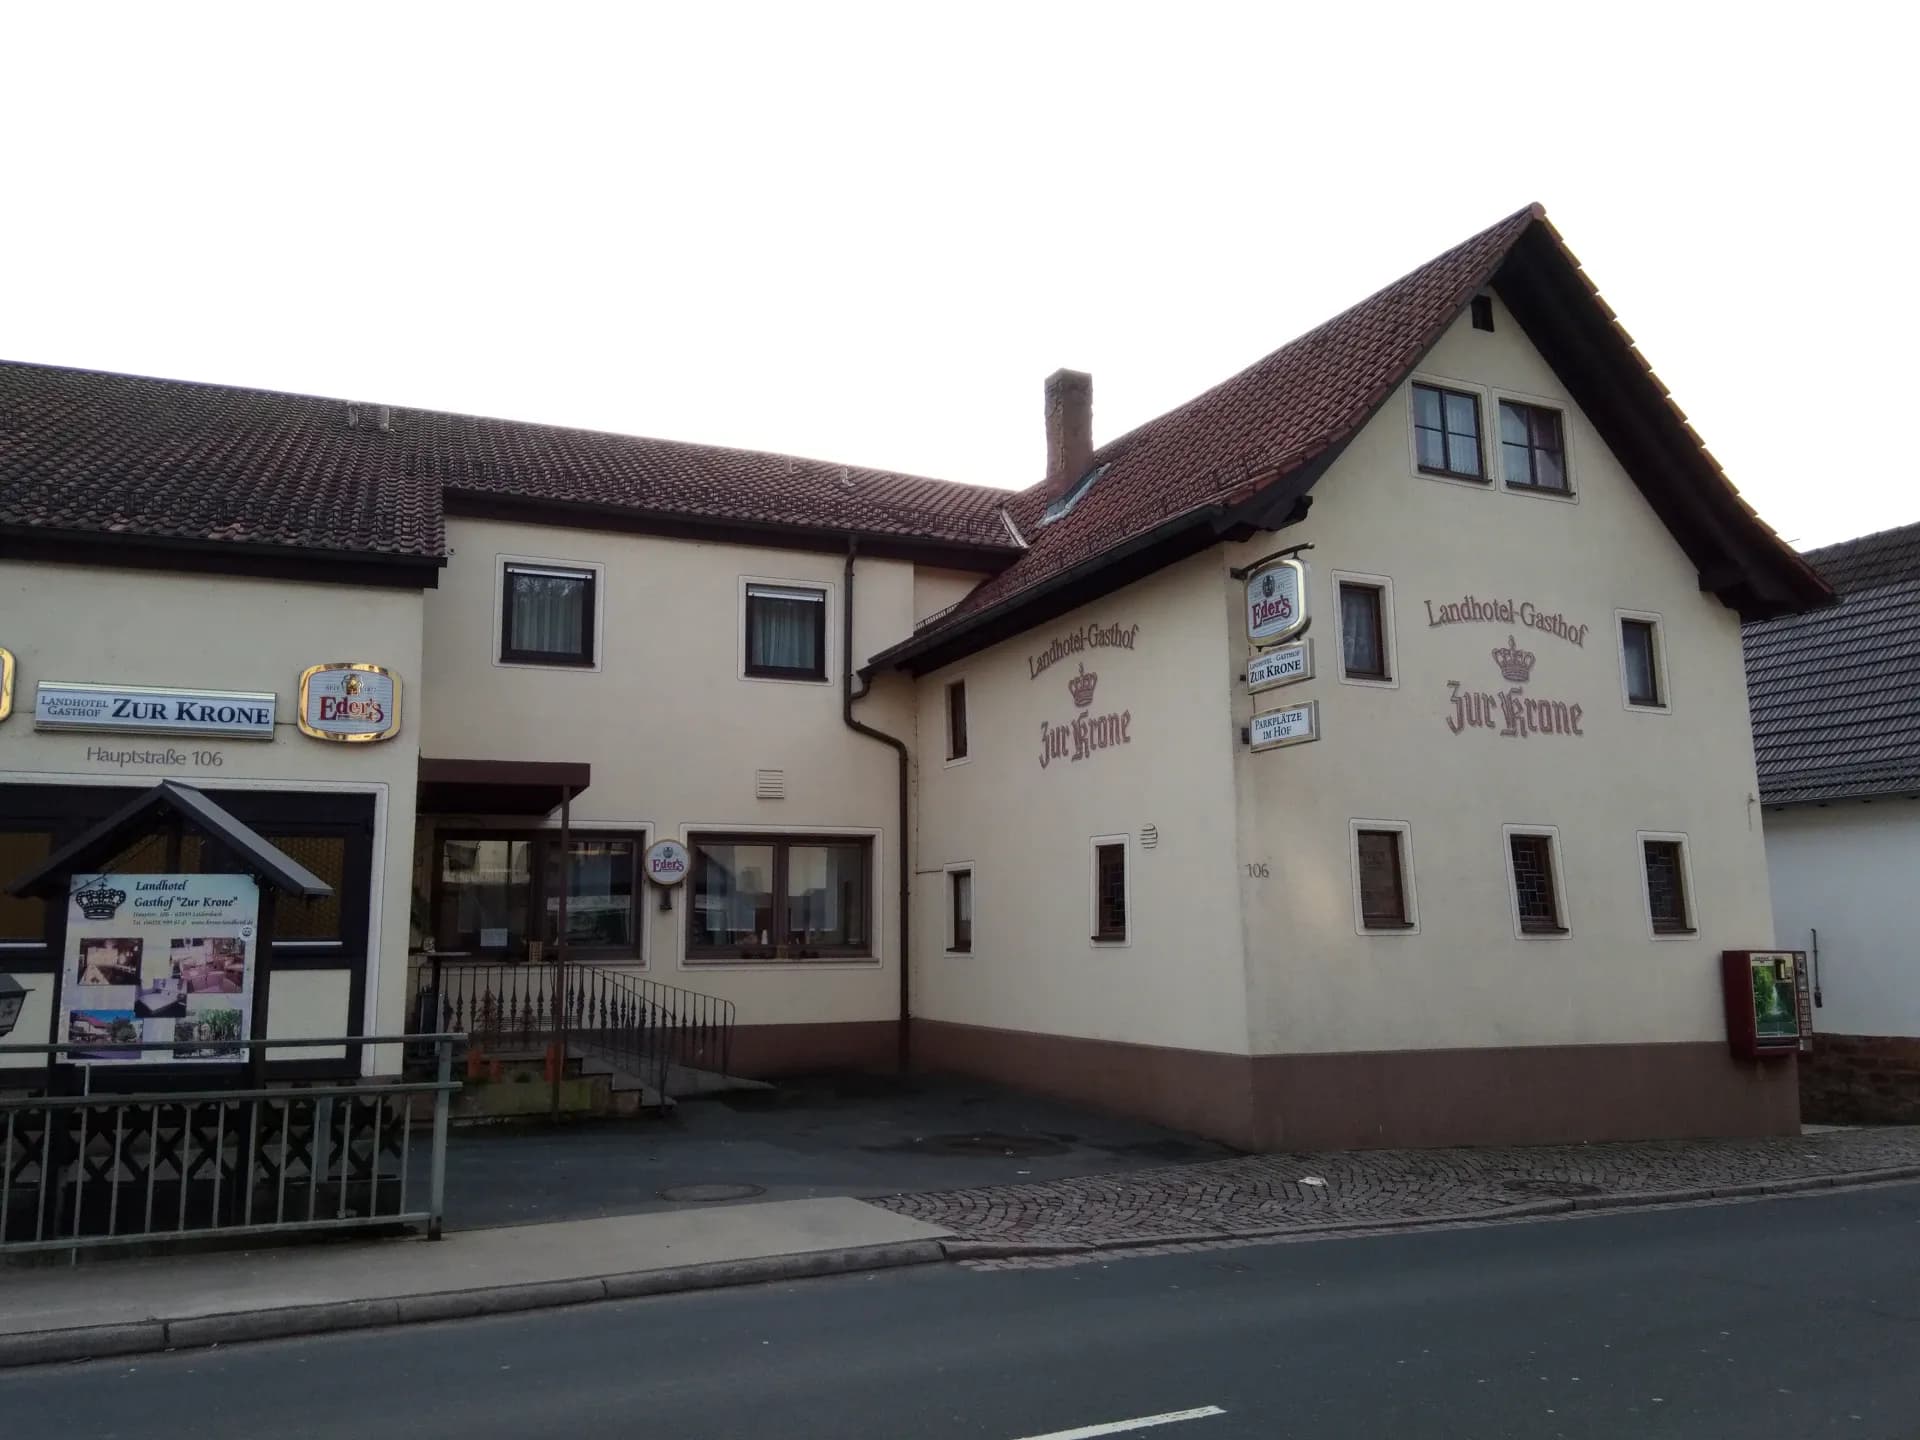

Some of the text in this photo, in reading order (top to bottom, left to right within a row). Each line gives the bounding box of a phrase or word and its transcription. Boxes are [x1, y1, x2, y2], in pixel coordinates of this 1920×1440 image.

[1252, 594, 1292, 629] Eder's
[1424, 595, 1589, 648] Landhotel-Gasthof
[1028, 622, 1139, 680] Landhotel-Gasthof
[1250, 660, 1301, 683] ZUR KRONE
[41, 695, 108, 708] LANDHOTEL
[48, 705, 101, 717] GASTHOF
[112, 698, 270, 725] ZUR KRONE
[319, 696, 384, 723] Eder's
[1446, 680, 1584, 738] Zur Krone
[1255, 712, 1302, 730] PARKPLÄTZE
[1274, 726, 1292, 737] HOF
[1039, 709, 1131, 769] Zur Krone
[86, 746, 224, 767] Hauptstraße 106
[653, 858, 684, 872] Eder's
[1245, 863, 1270, 878] 106
[136, 880, 188, 891] Landhotel
[134, 896, 176, 911] Gasthof
